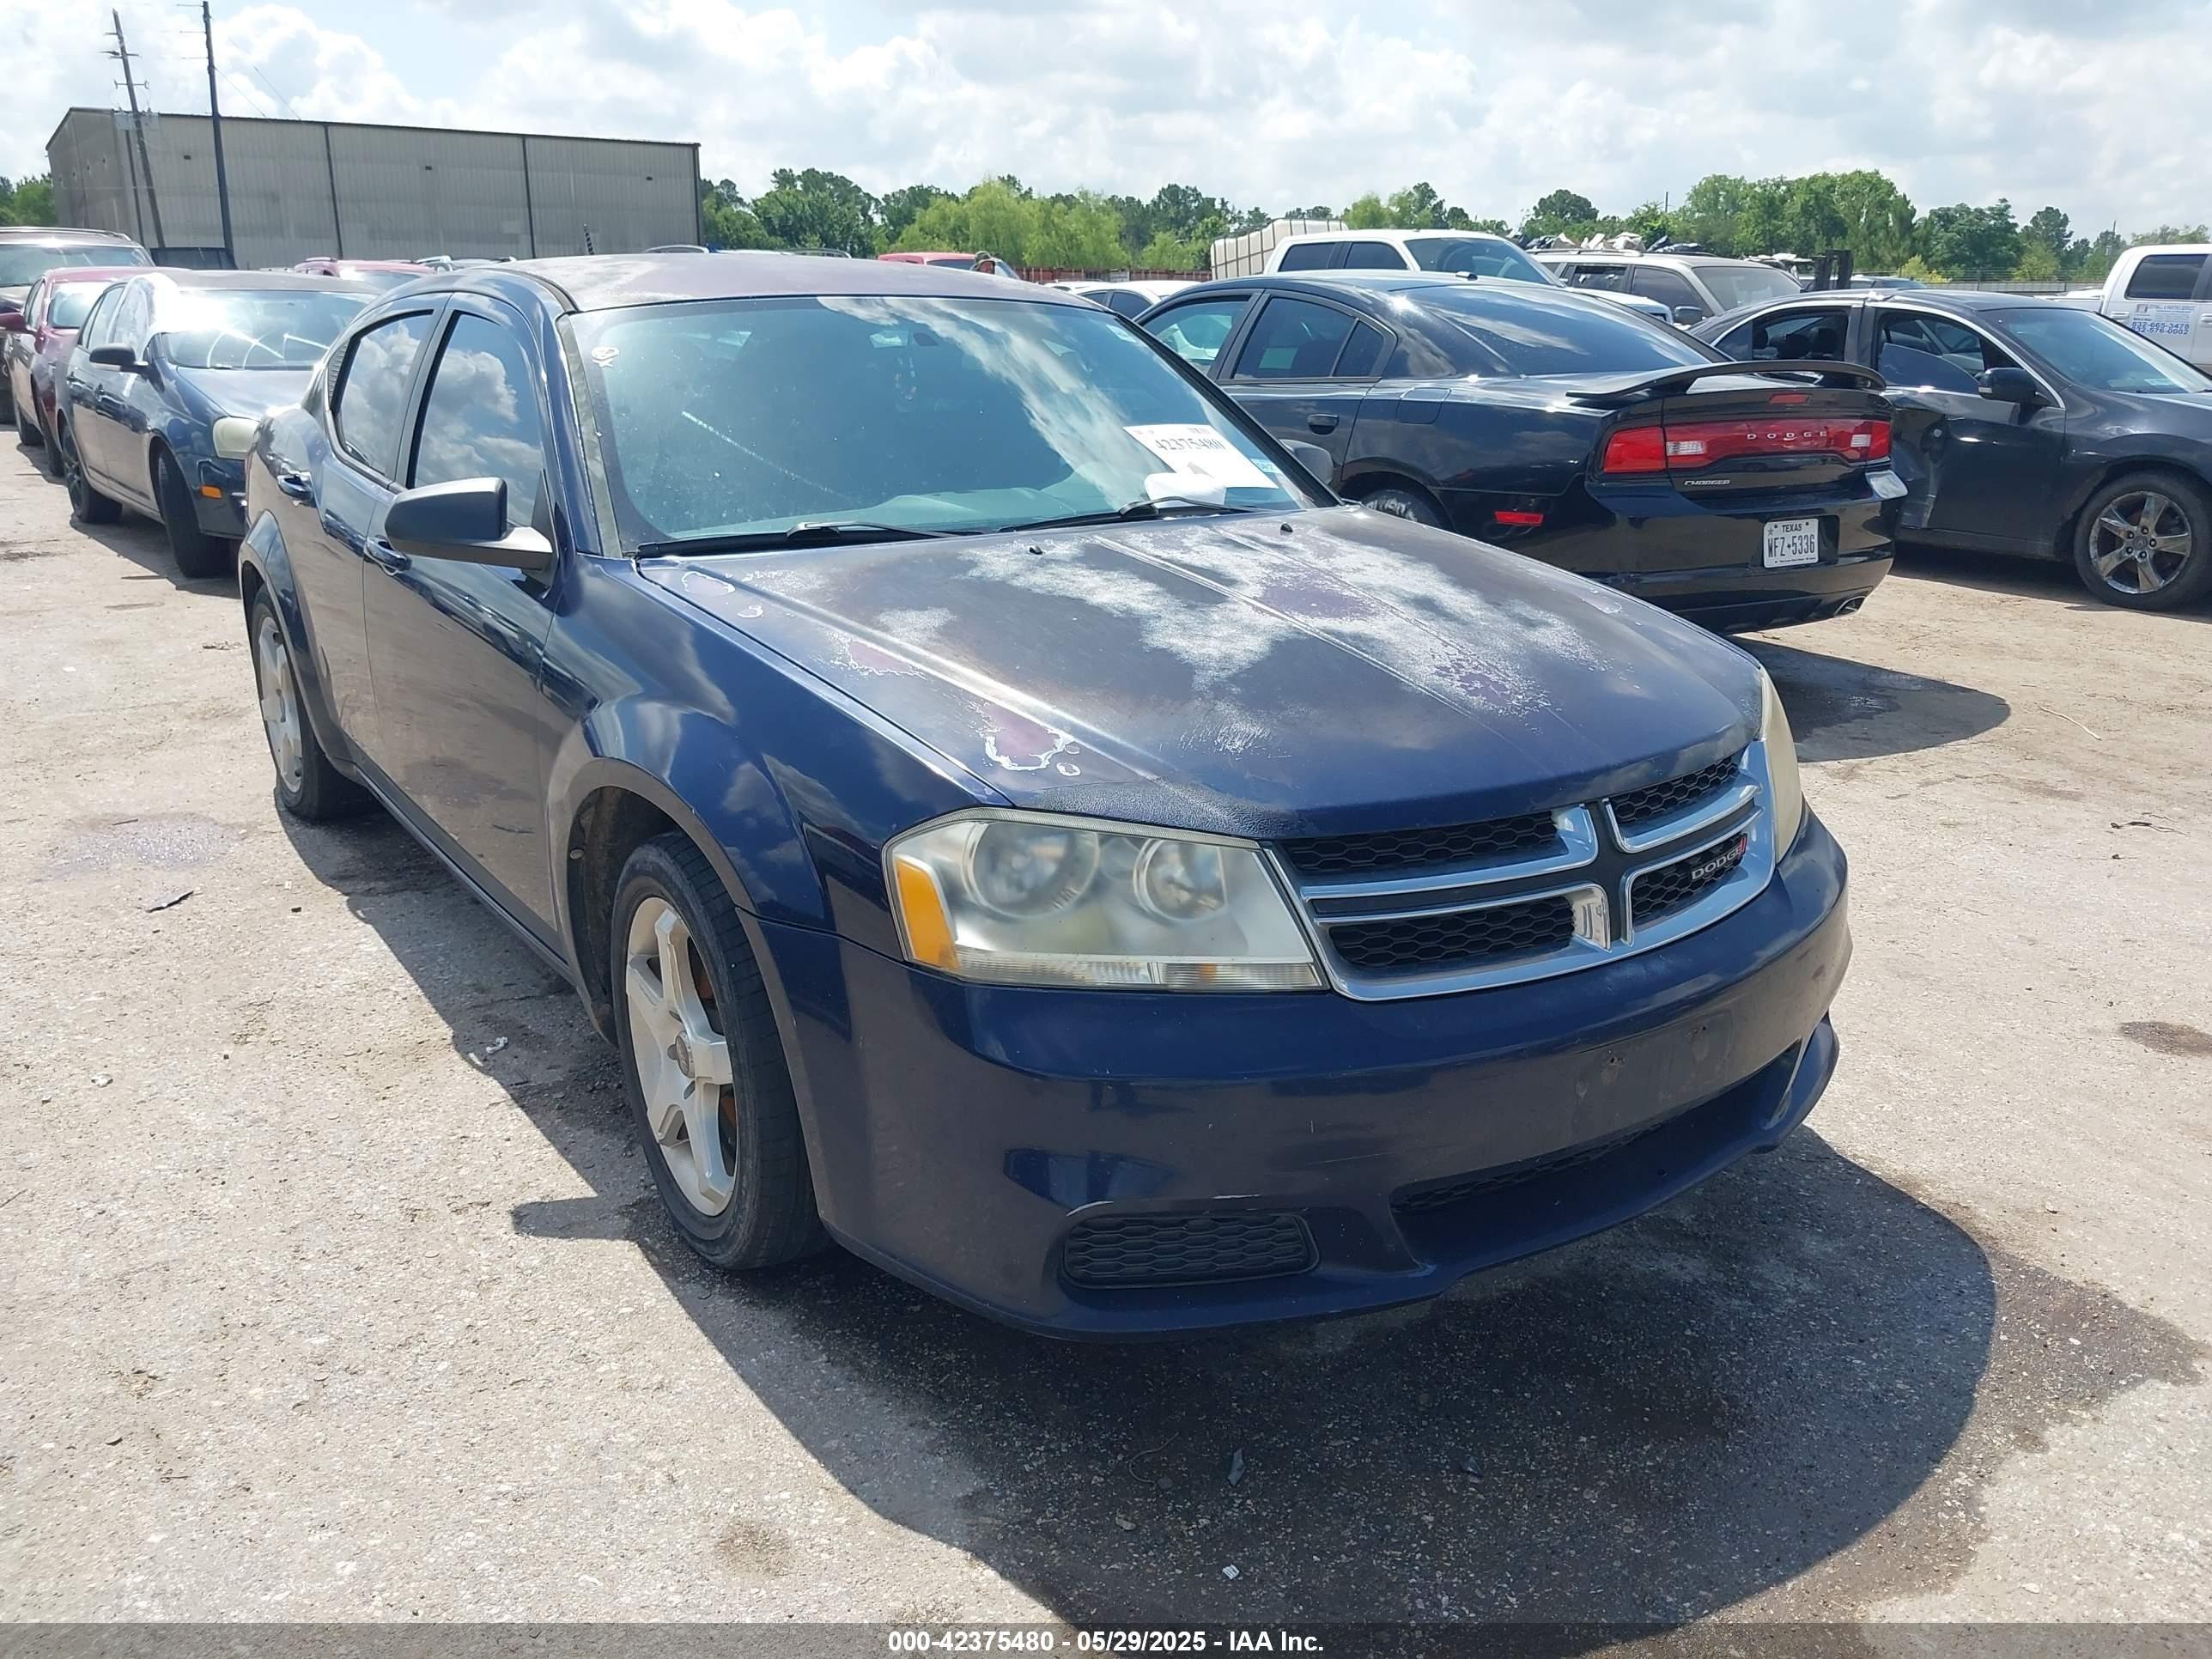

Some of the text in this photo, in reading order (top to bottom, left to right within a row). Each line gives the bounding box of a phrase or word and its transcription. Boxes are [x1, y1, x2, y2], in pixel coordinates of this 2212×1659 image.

[1747, 431, 1827, 440] DODGE
[1155, 438, 1226, 451] 42375480
[1782, 523, 1802, 533] TEXAS
[1692, 844, 1742, 880] DODGE
